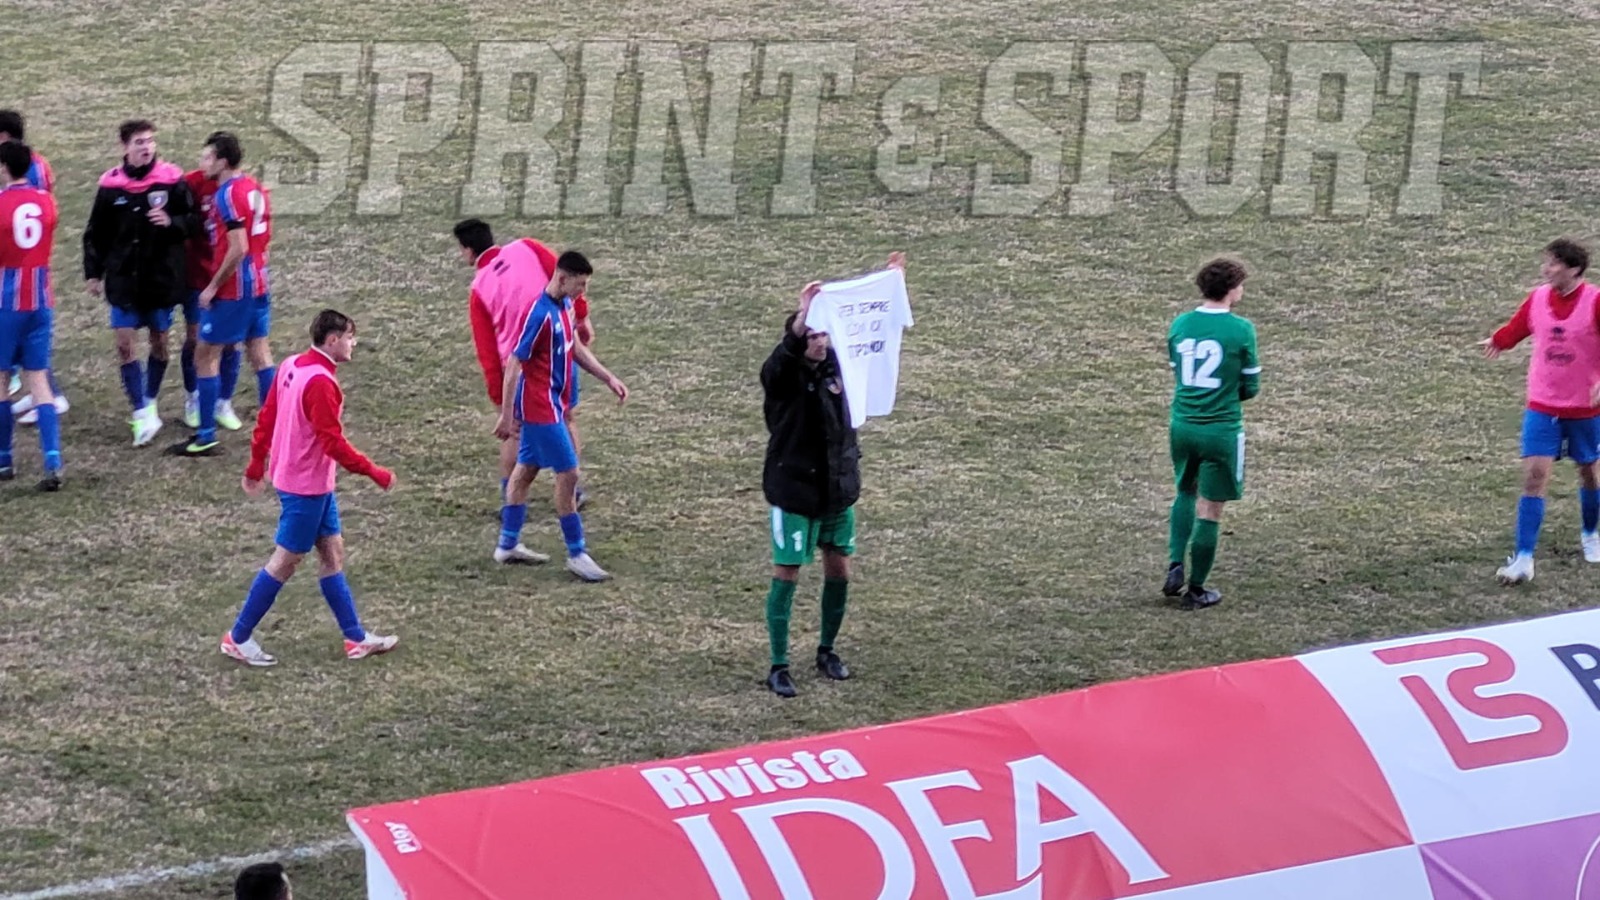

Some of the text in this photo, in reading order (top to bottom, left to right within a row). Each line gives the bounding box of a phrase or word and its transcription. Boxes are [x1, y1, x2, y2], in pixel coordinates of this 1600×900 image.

[13, 203, 43, 249] 6
[1176, 338, 1223, 389] 12
[791, 531, 803, 552] 1
[641, 748, 868, 808] Rivista
[674, 754, 1171, 900] IDEA
